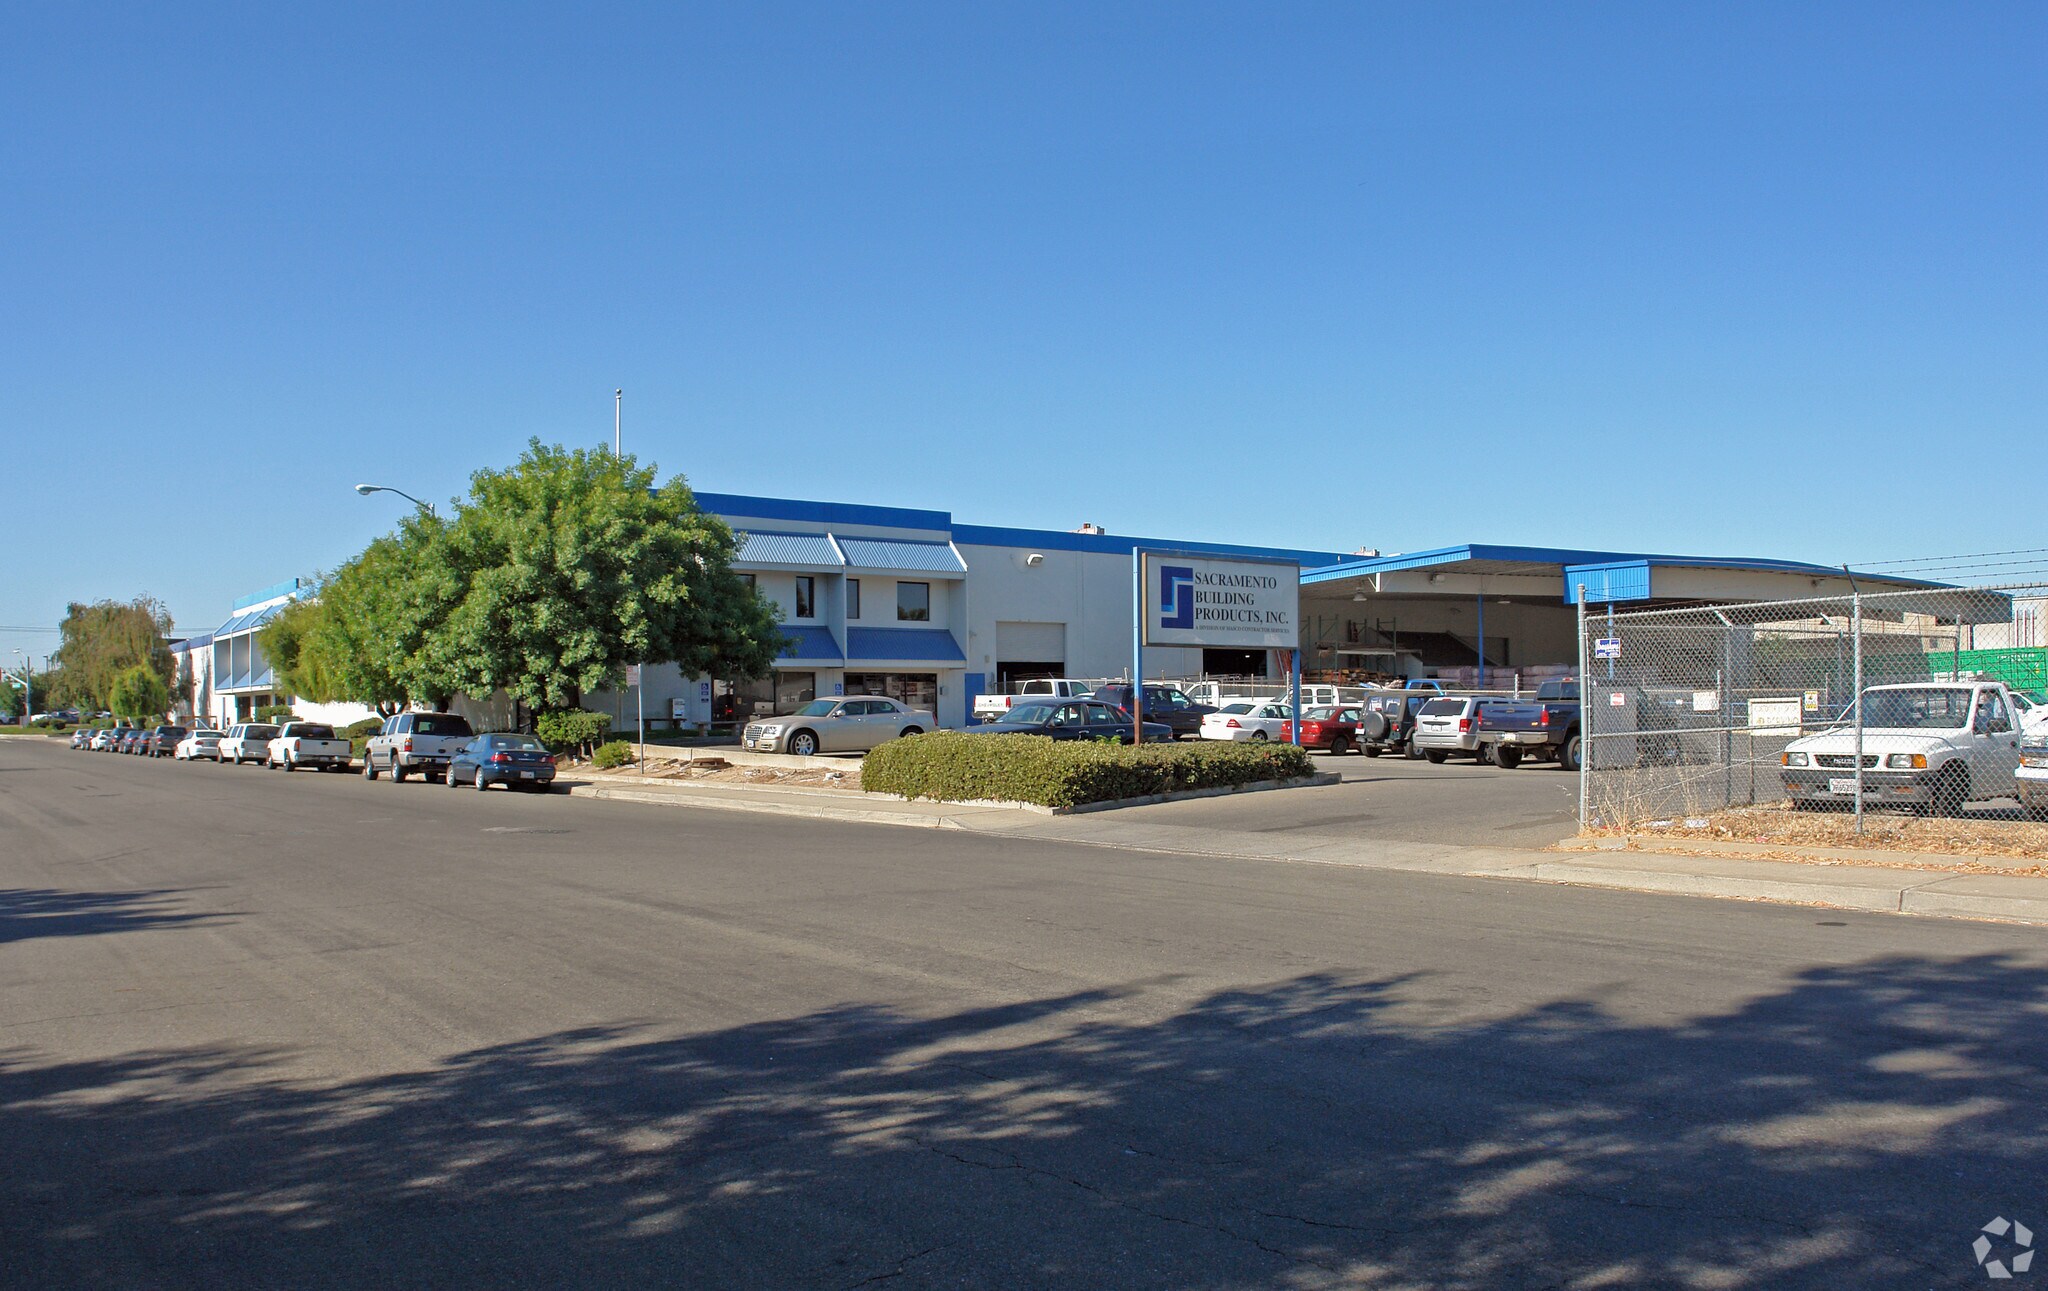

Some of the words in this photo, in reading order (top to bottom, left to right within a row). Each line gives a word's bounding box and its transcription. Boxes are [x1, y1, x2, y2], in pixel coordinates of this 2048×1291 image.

[1195, 572, 1277, 589] SACRAMENTO
[1195, 591, 1255, 606] BUILDING
[1195, 608, 1263, 624] PRODUCTS,
[1266, 611, 1289, 624] INC.
